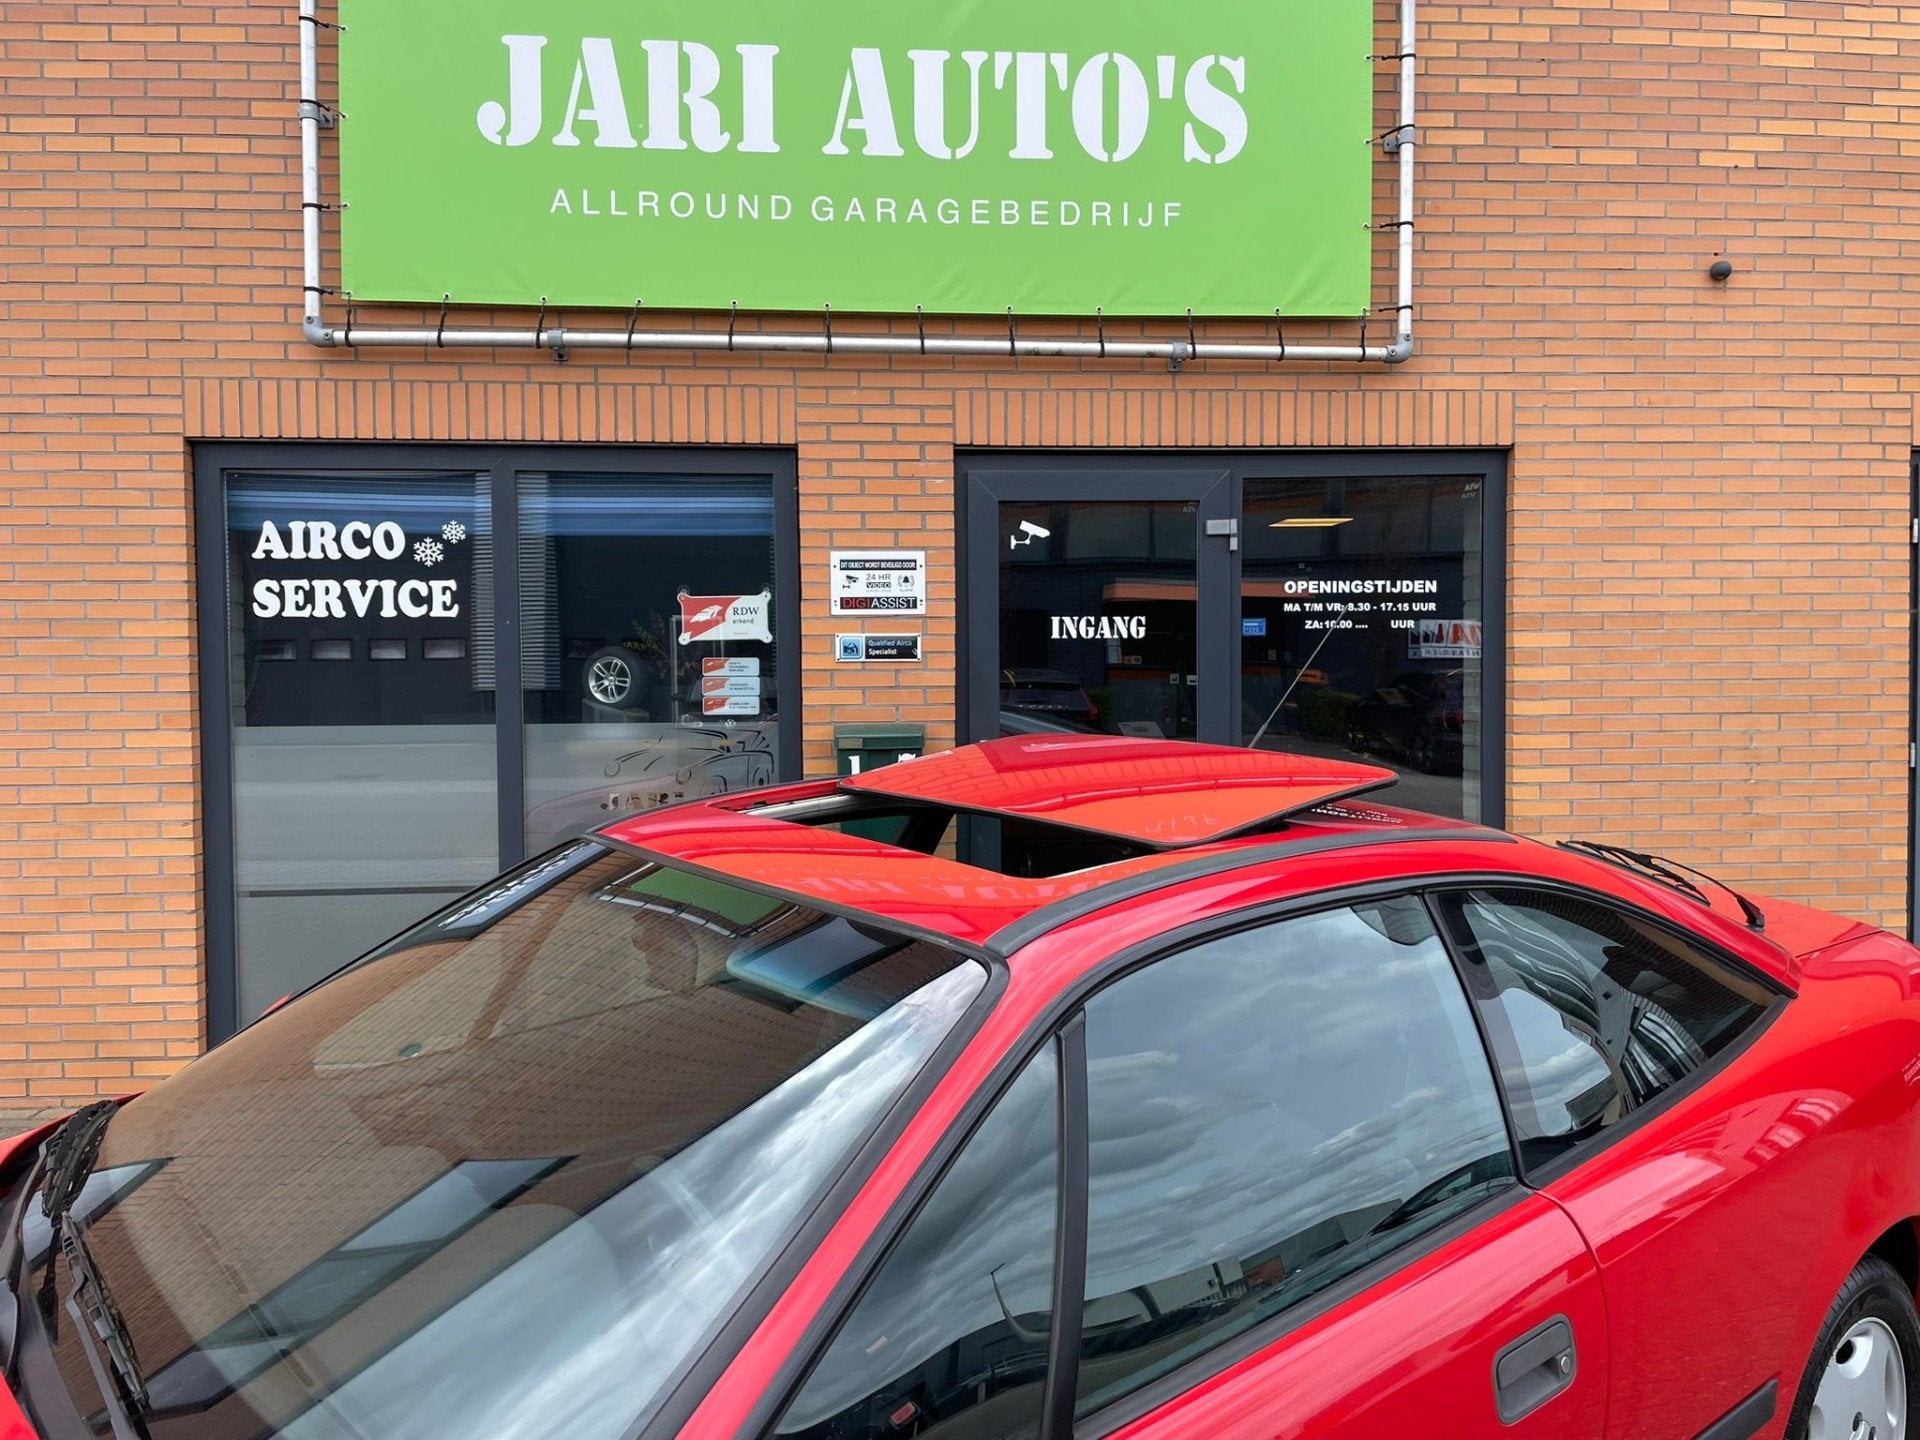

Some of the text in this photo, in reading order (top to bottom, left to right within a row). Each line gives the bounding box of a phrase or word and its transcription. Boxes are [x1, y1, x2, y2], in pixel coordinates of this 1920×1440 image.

[477, 35, 1248, 164] JARI AUTO'S
[551, 189, 1182, 228] ALLROUND GARAGEBEDRIJF
[251, 520, 406, 560] AIRCO
[252, 578, 460, 618] SERVICE
[1284, 580, 1437, 594] OPENINGSTIJDEN
[733, 607, 759, 616] RDW
[1284, 603, 1301, 612] MA
[1304, 603, 1323, 612] T/M
[1326, 603, 1344, 611] VR:
[1348, 602, 1371, 611] 8.30
[1380, 602, 1409, 611] 17.15
[1412, 602, 1437, 611] UUR
[1051, 616, 1146, 639] INGANG
[1391, 619, 1415, 628] UUR
